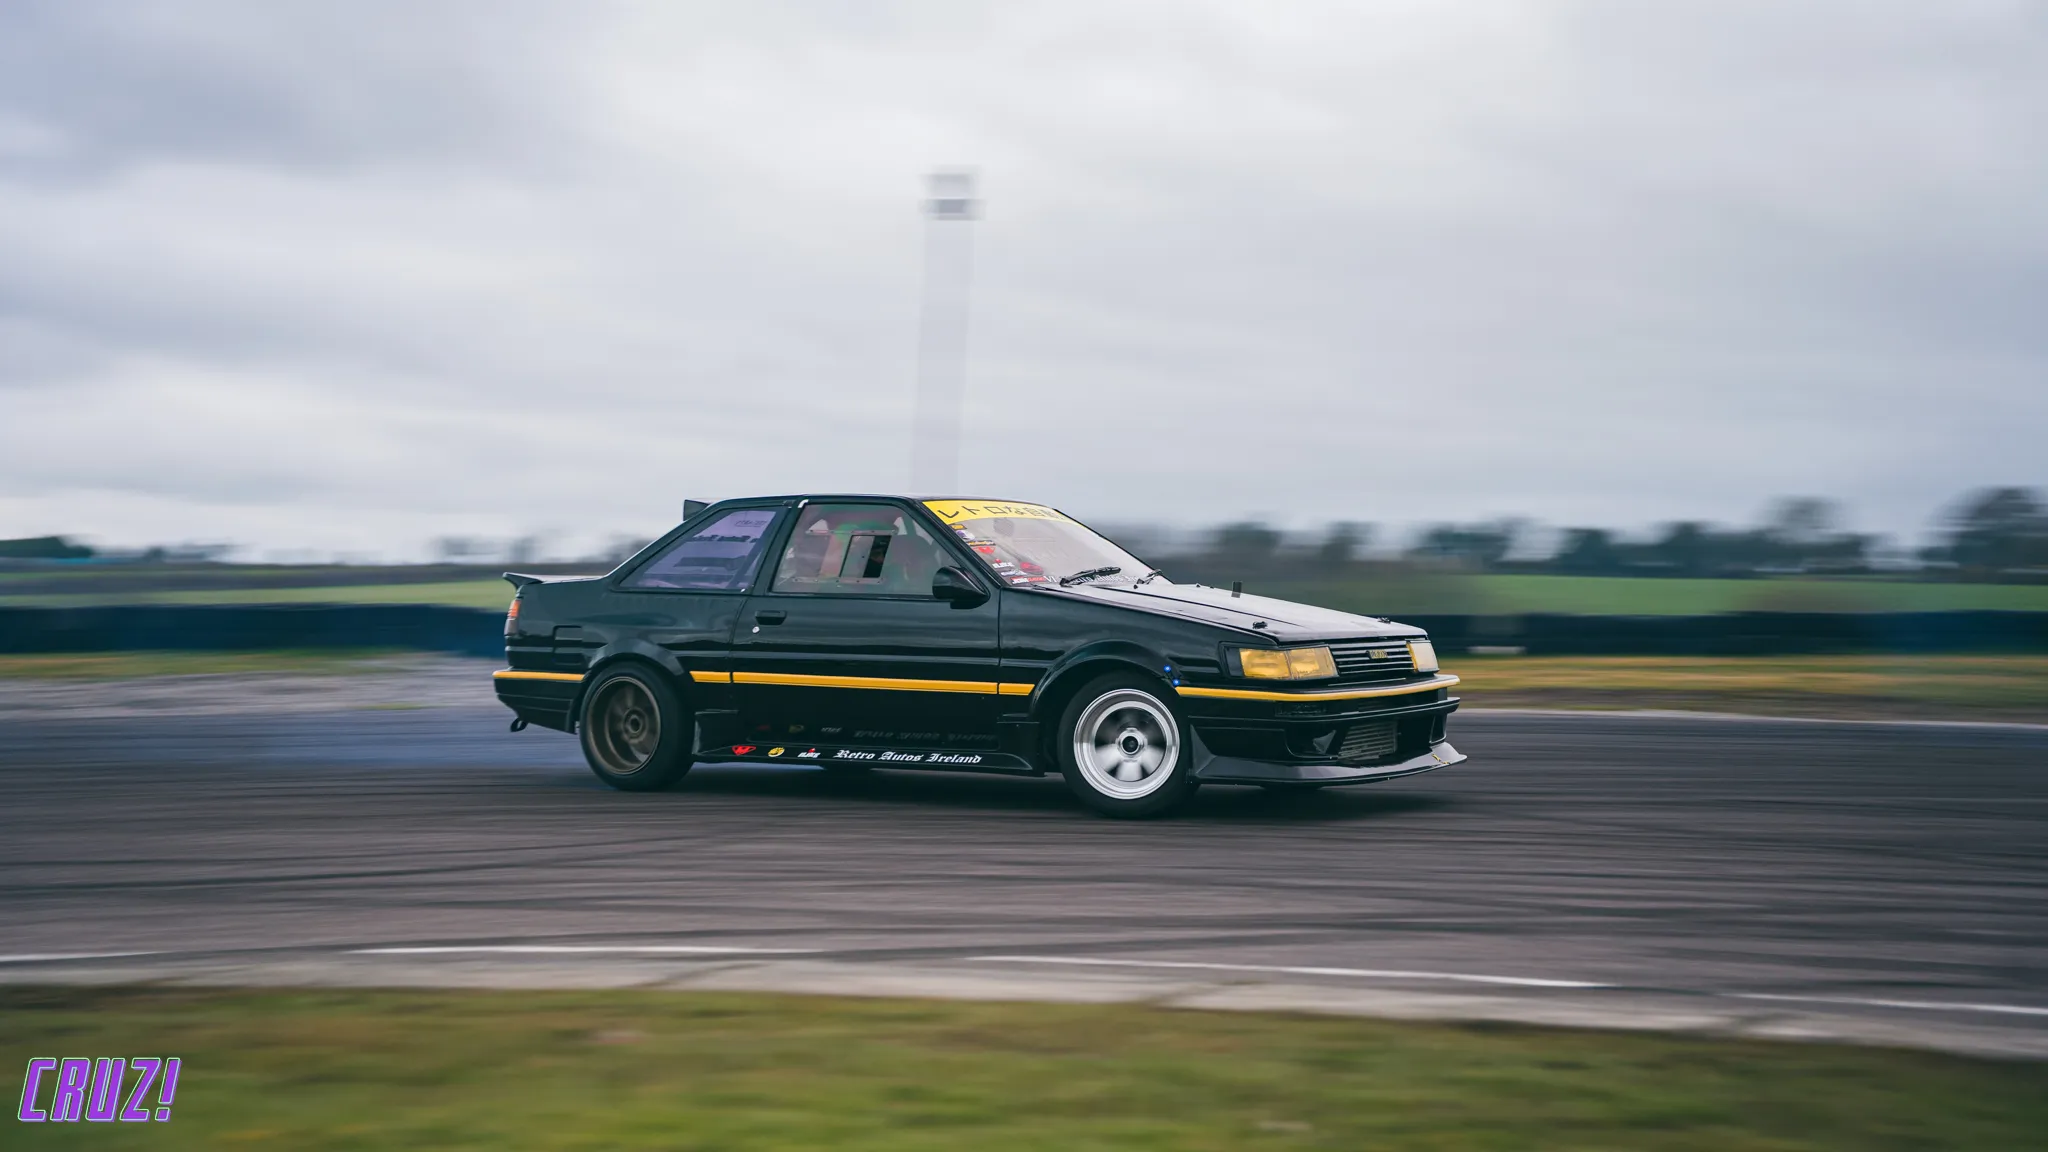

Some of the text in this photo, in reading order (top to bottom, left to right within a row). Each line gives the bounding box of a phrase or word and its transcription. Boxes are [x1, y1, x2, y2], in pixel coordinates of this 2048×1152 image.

[833, 749, 875, 759] Retro
[878, 751, 924, 762] Autos
[925, 753, 982, 764] Ireland
